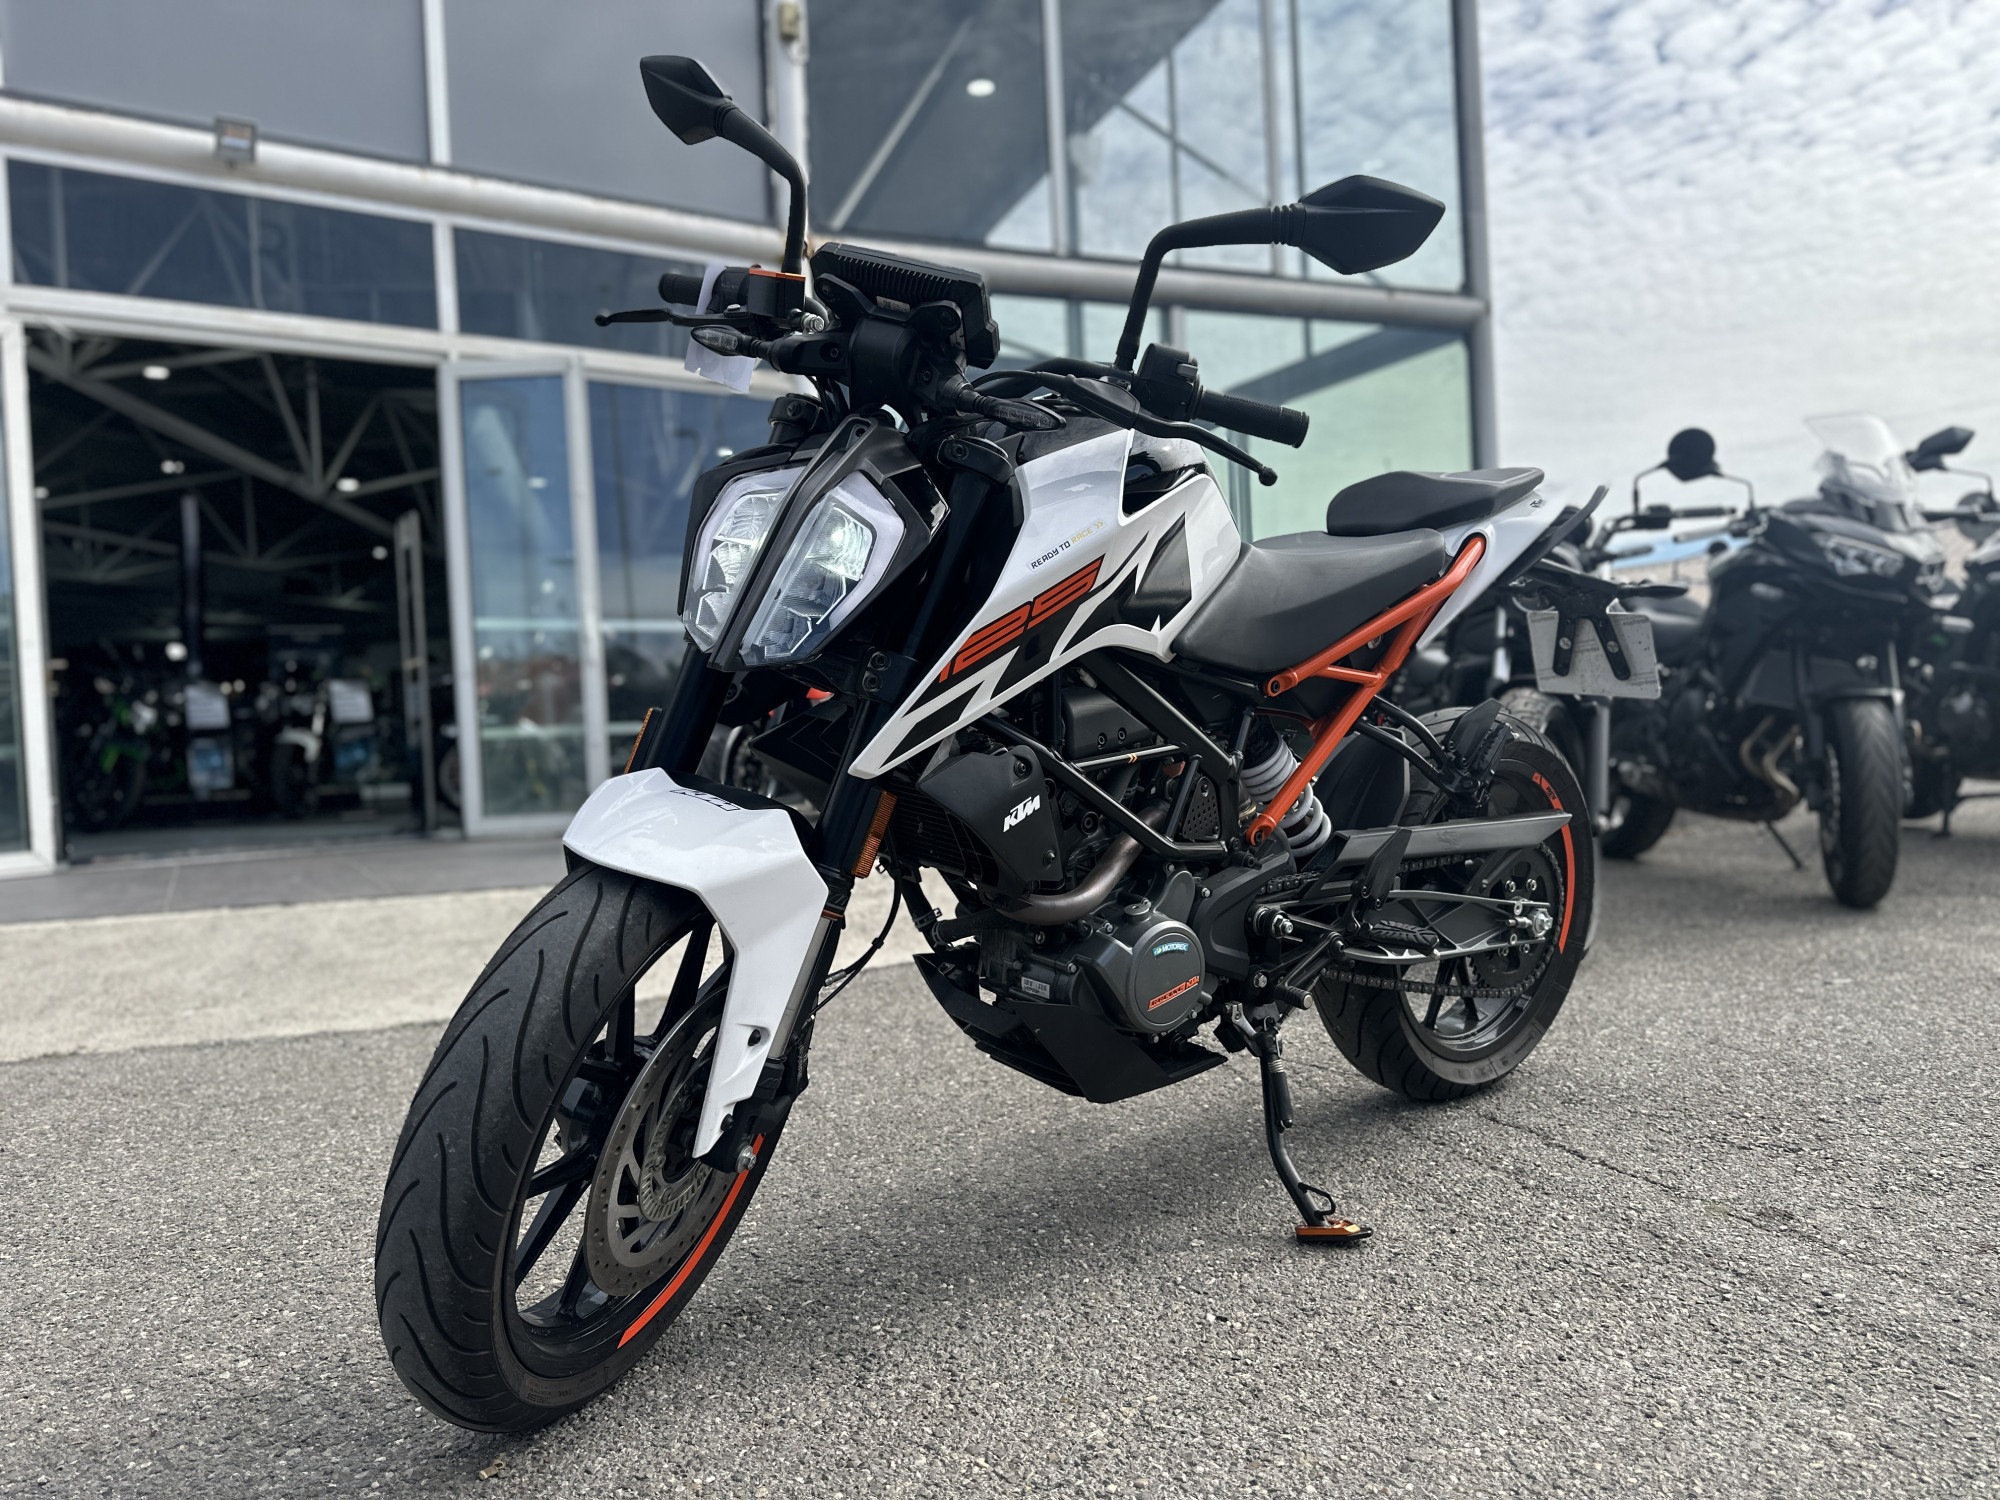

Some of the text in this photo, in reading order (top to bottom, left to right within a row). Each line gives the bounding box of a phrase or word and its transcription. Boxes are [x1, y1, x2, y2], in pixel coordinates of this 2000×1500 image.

[1030, 527, 1094, 569] READY TO RACE
[938, 554, 1105, 684] 125
[1003, 795, 1041, 833] KTM
